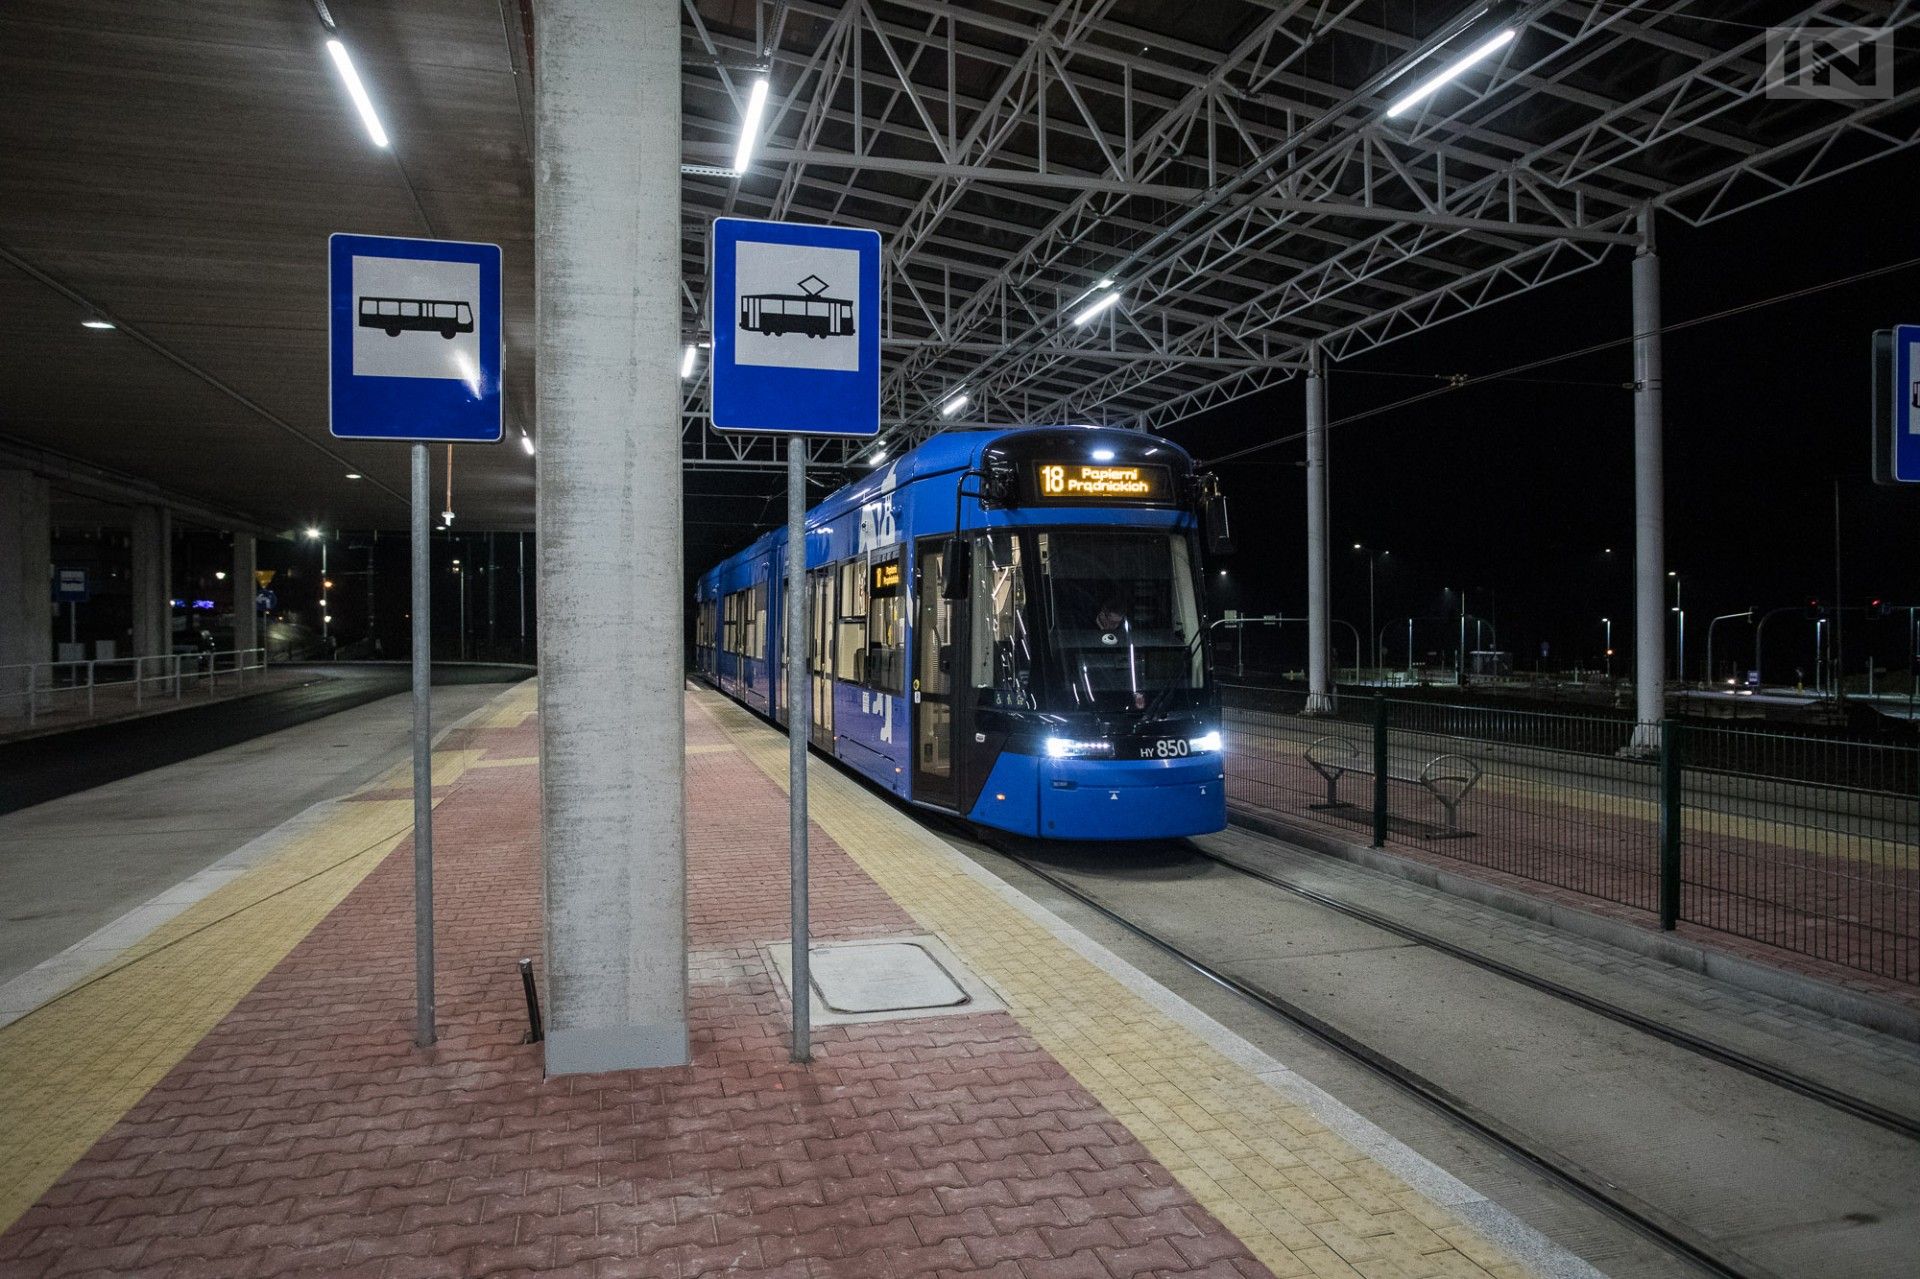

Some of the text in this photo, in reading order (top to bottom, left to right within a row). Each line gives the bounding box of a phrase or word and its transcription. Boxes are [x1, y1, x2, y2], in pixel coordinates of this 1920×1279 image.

[1042, 466, 1064, 492] 18
[1082, 467, 1138, 480] Papierni
[1140, 739, 1188, 757] HY 850
